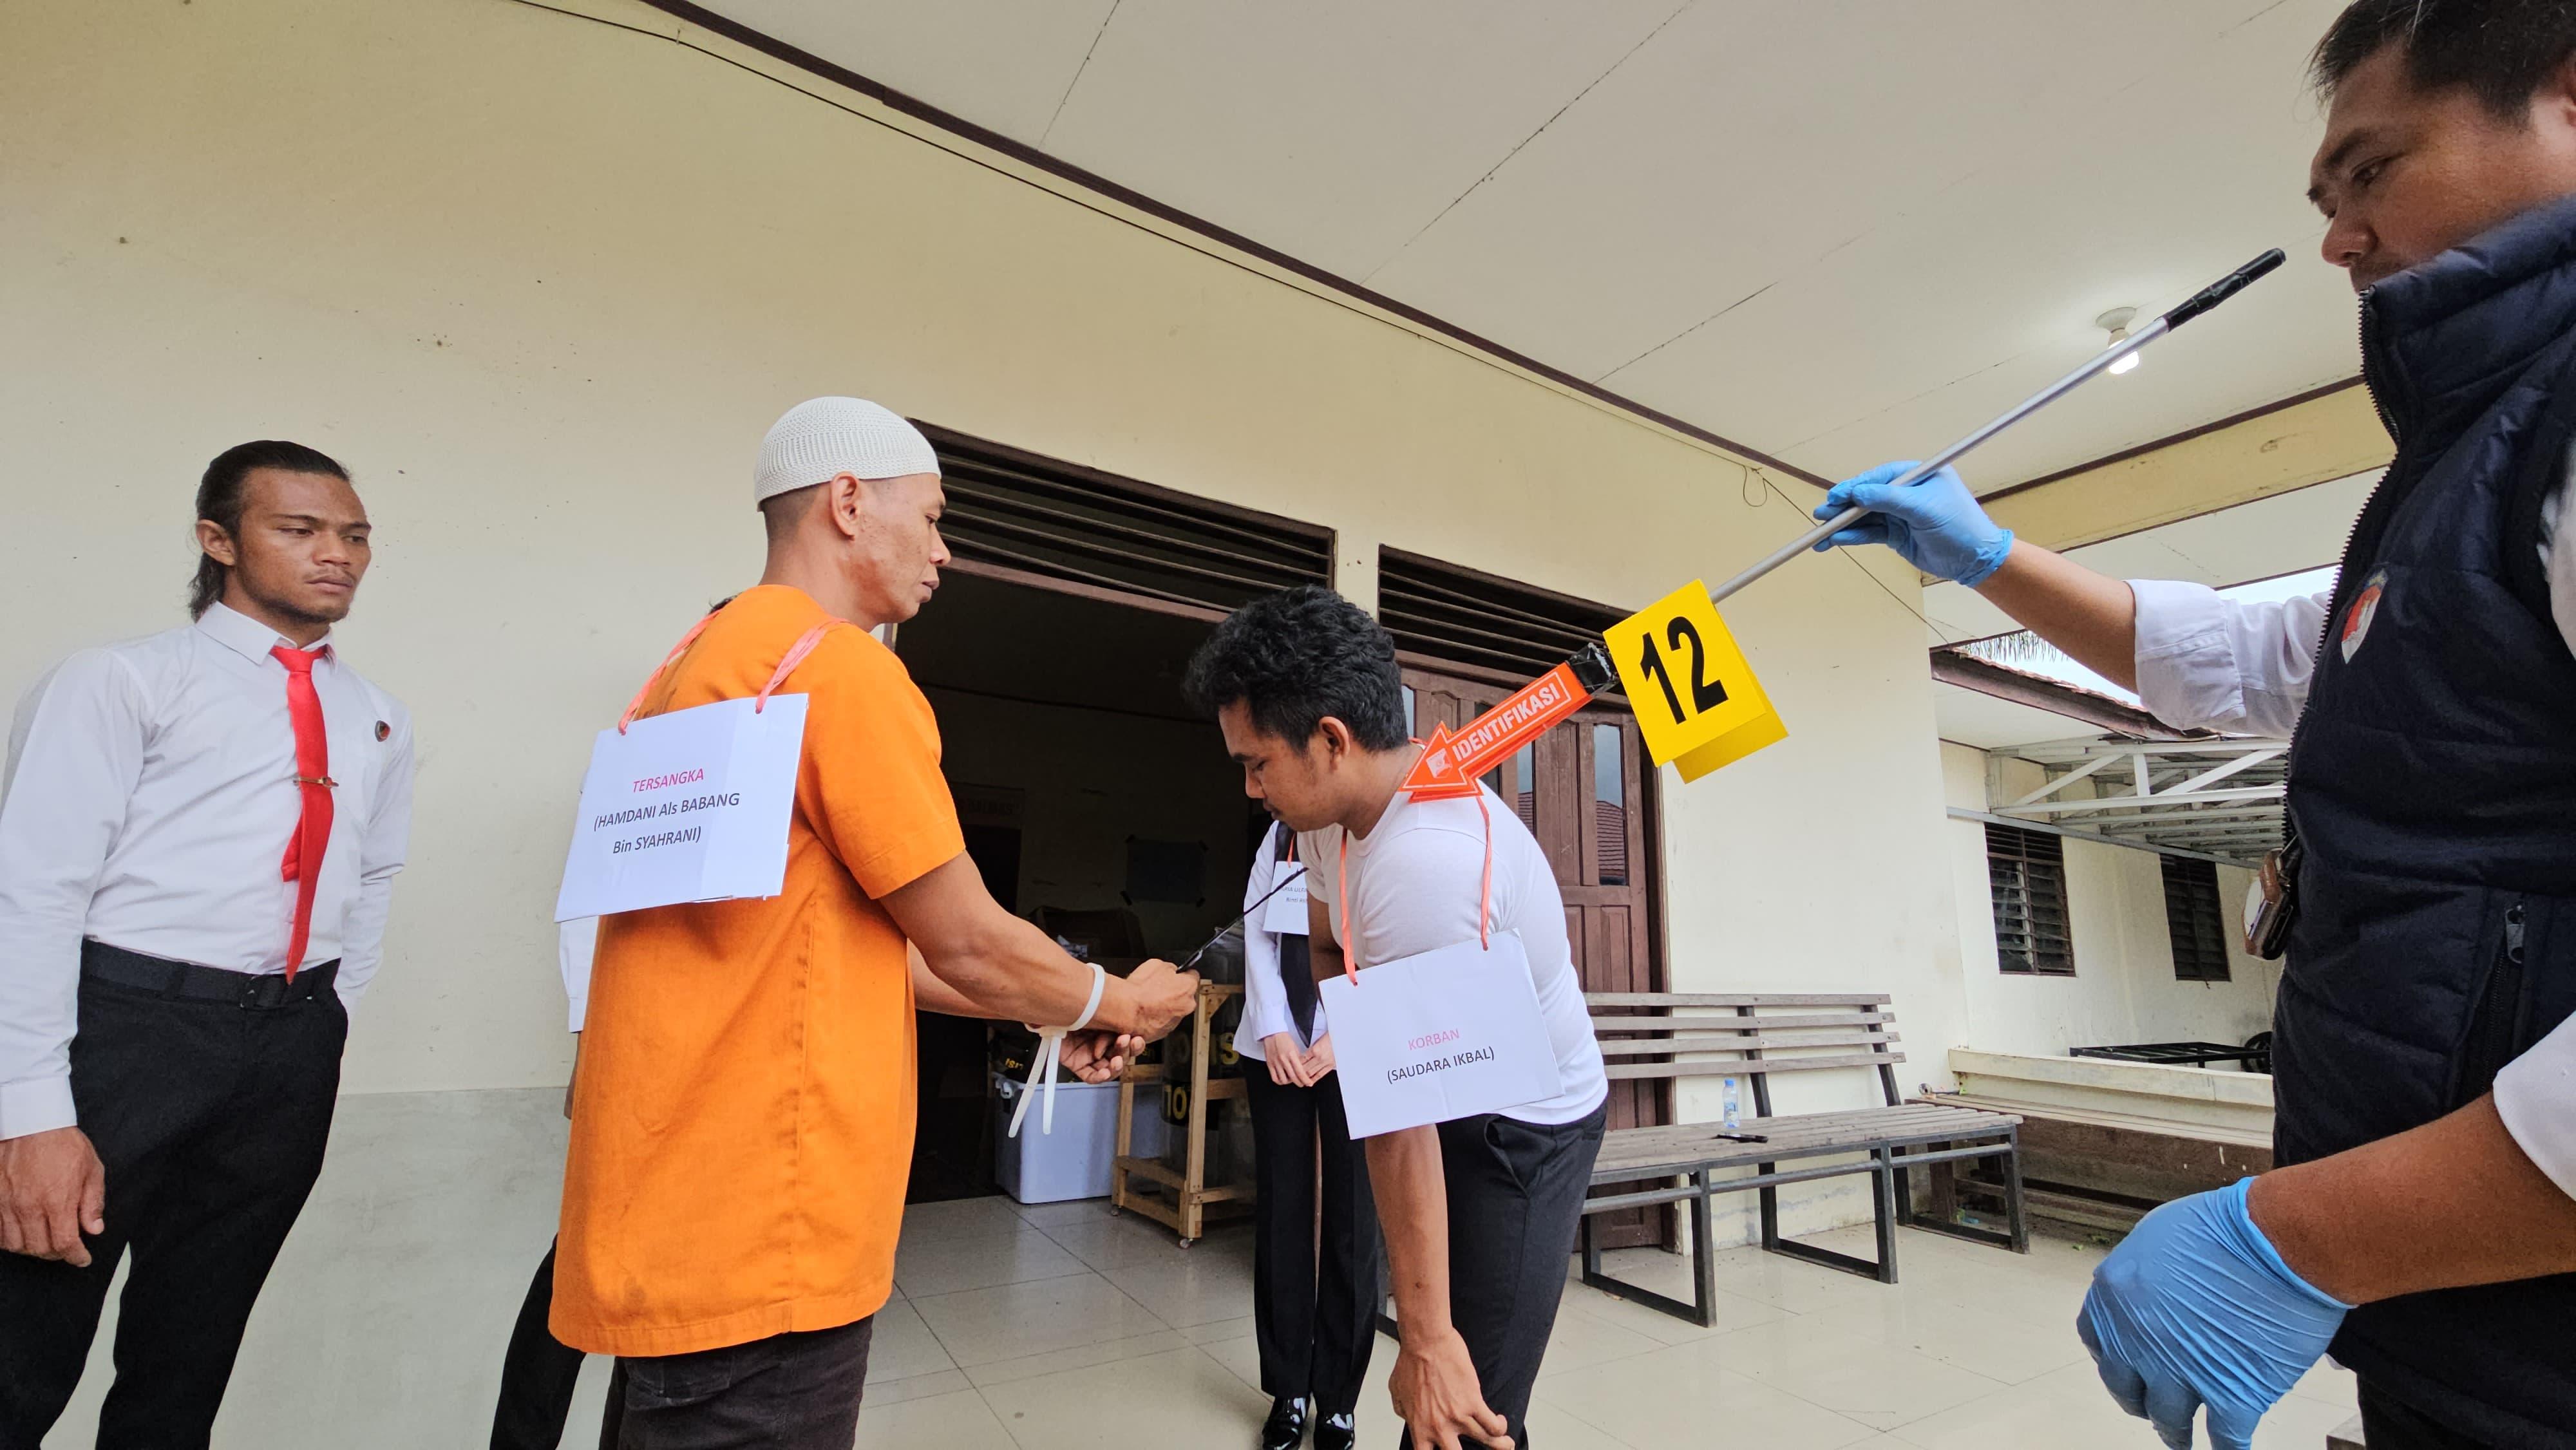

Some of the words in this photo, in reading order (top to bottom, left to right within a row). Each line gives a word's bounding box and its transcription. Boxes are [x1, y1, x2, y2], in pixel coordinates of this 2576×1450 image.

[1640, 616, 1728, 725] 12
[1452, 682, 1560, 762] IDENTIFIKASI
[632, 768, 705, 793] TERSANGKA
[594, 805, 656, 832] (HAMDANI
[658, 802, 677, 818] Als
[681, 793, 740, 813] BABANG
[612, 840, 631, 854] Bin
[634, 826, 701, 851] SYAHRANI)
[1408, 1028, 1460, 1051] KORBAN
[1387, 1057, 1452, 1084] (SAUDARA
[1453, 1046, 1495, 1067] IKBAL)
